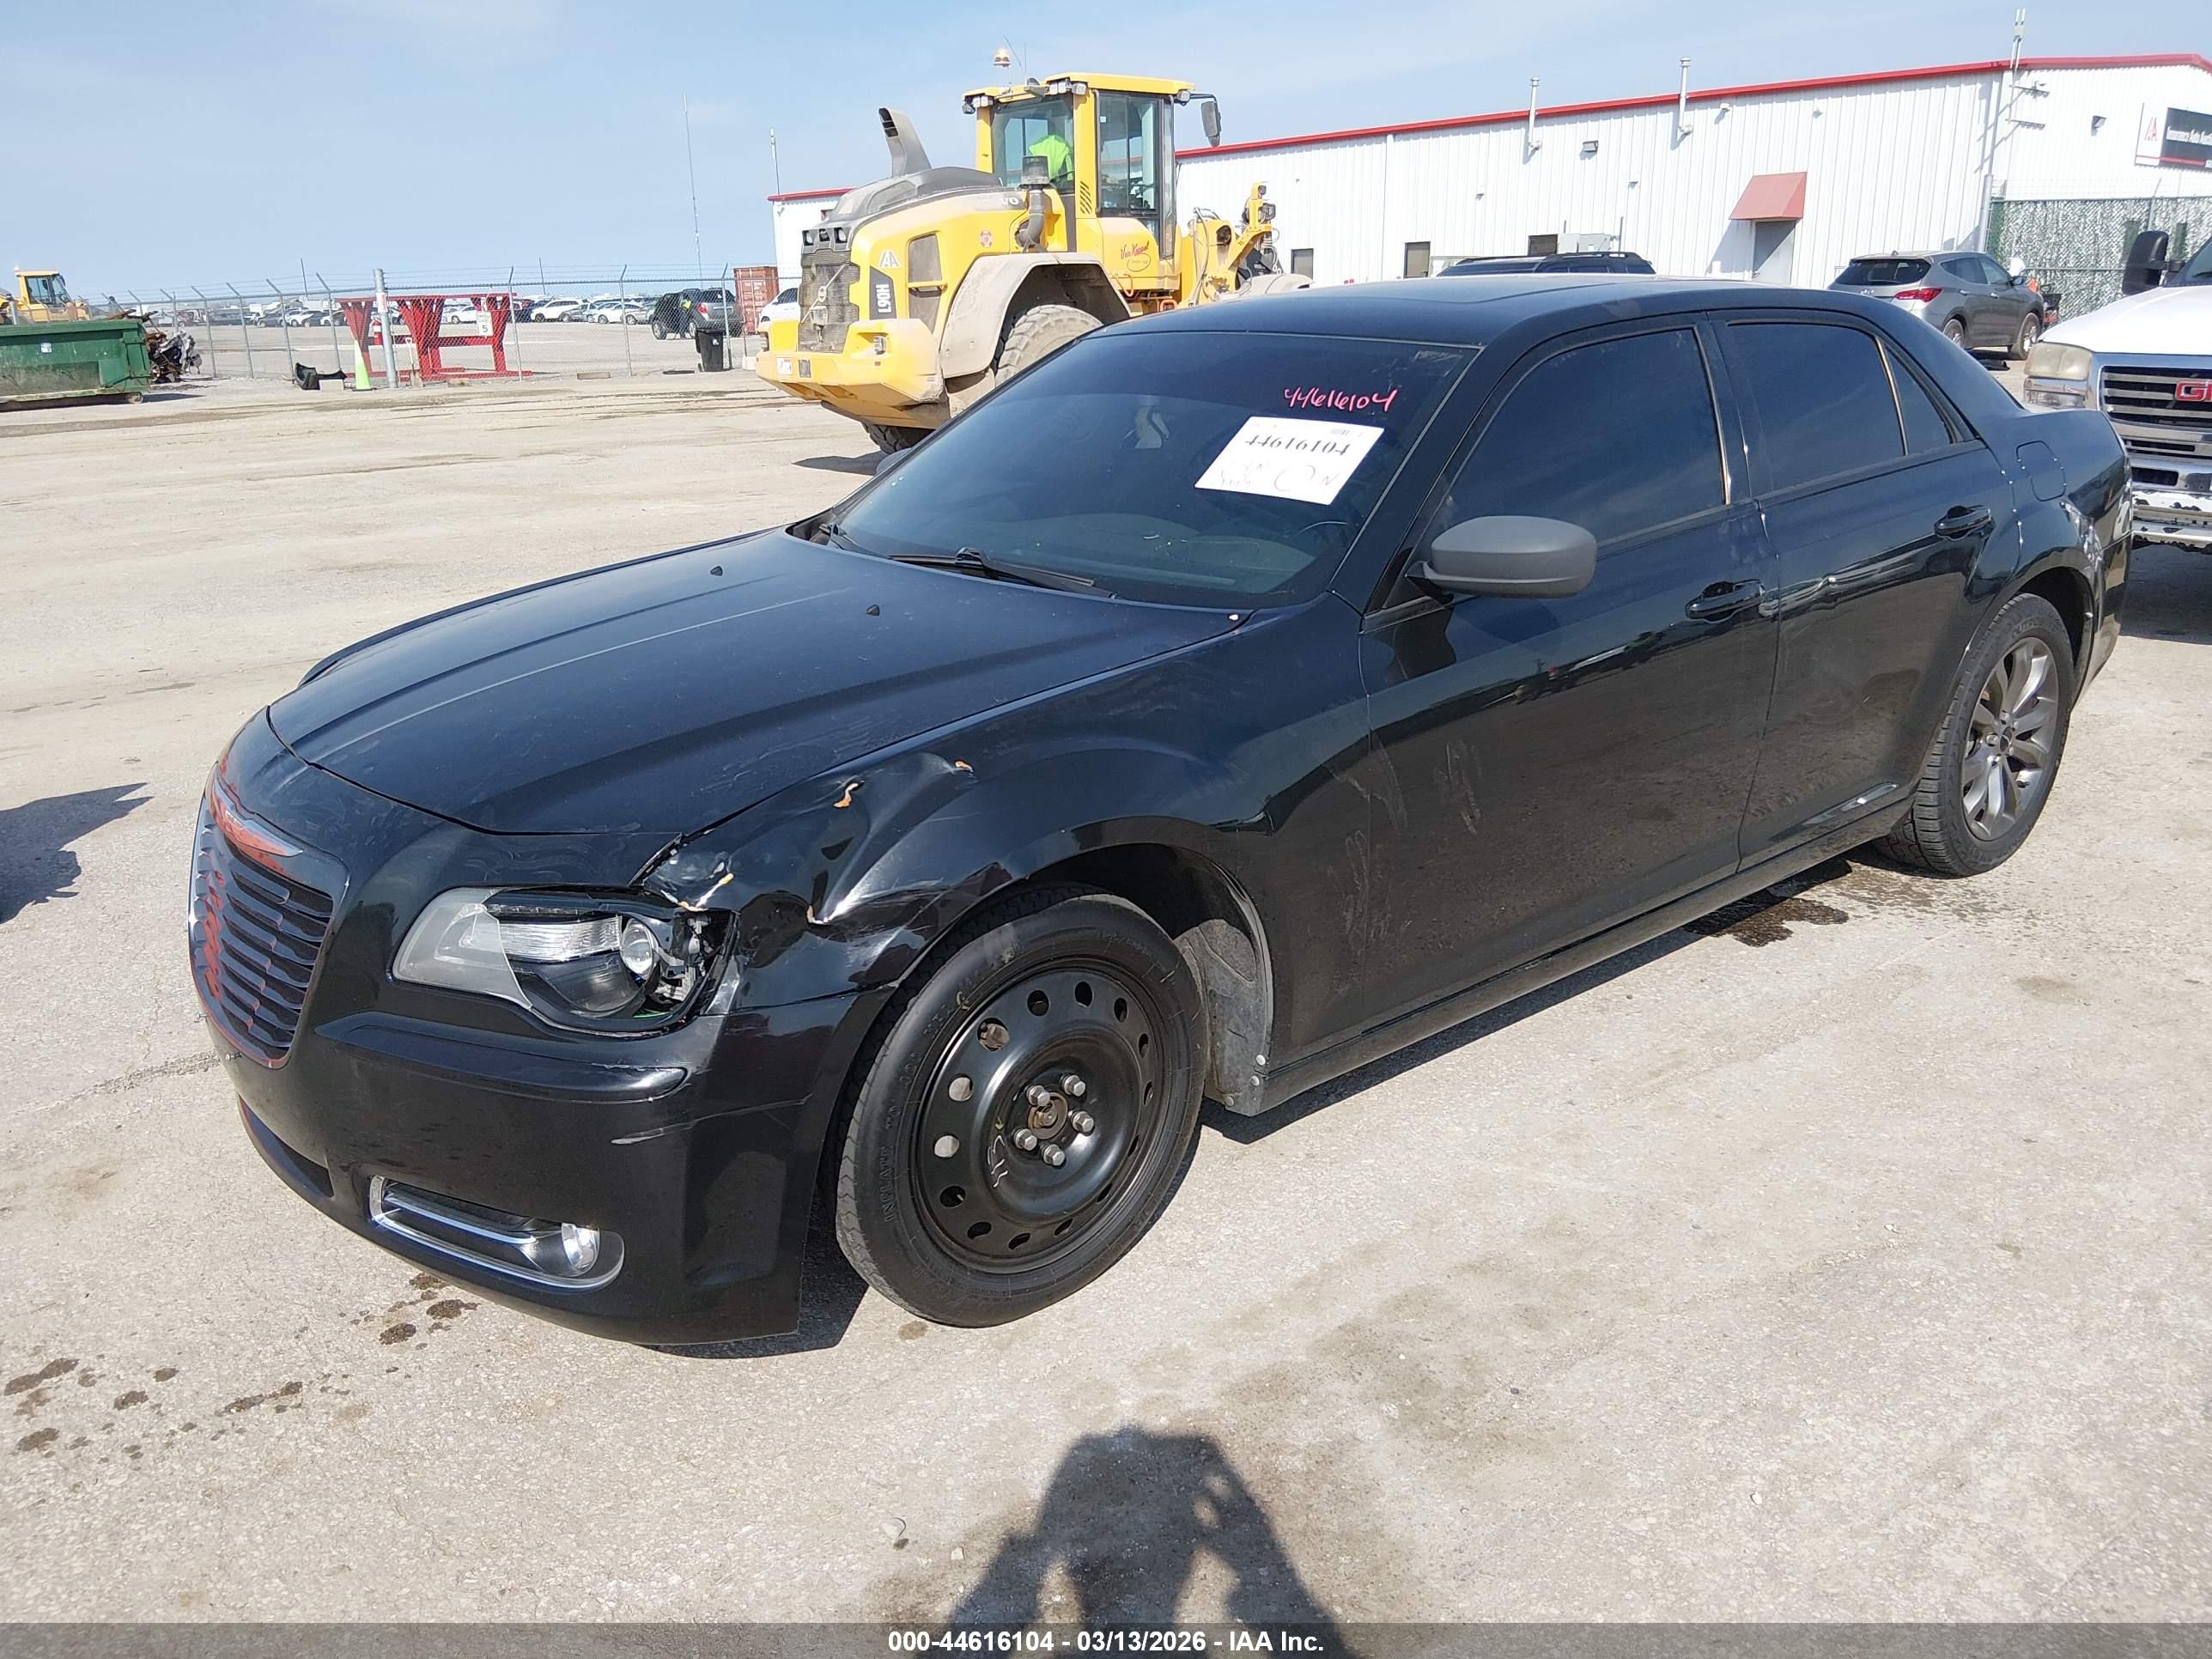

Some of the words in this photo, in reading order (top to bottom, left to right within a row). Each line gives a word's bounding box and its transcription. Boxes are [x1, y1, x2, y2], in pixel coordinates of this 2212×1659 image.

[876, 284, 891, 313] L90H
[1285, 387, 1398, 412] 44616104
[1245, 434, 1351, 456] 44616104
